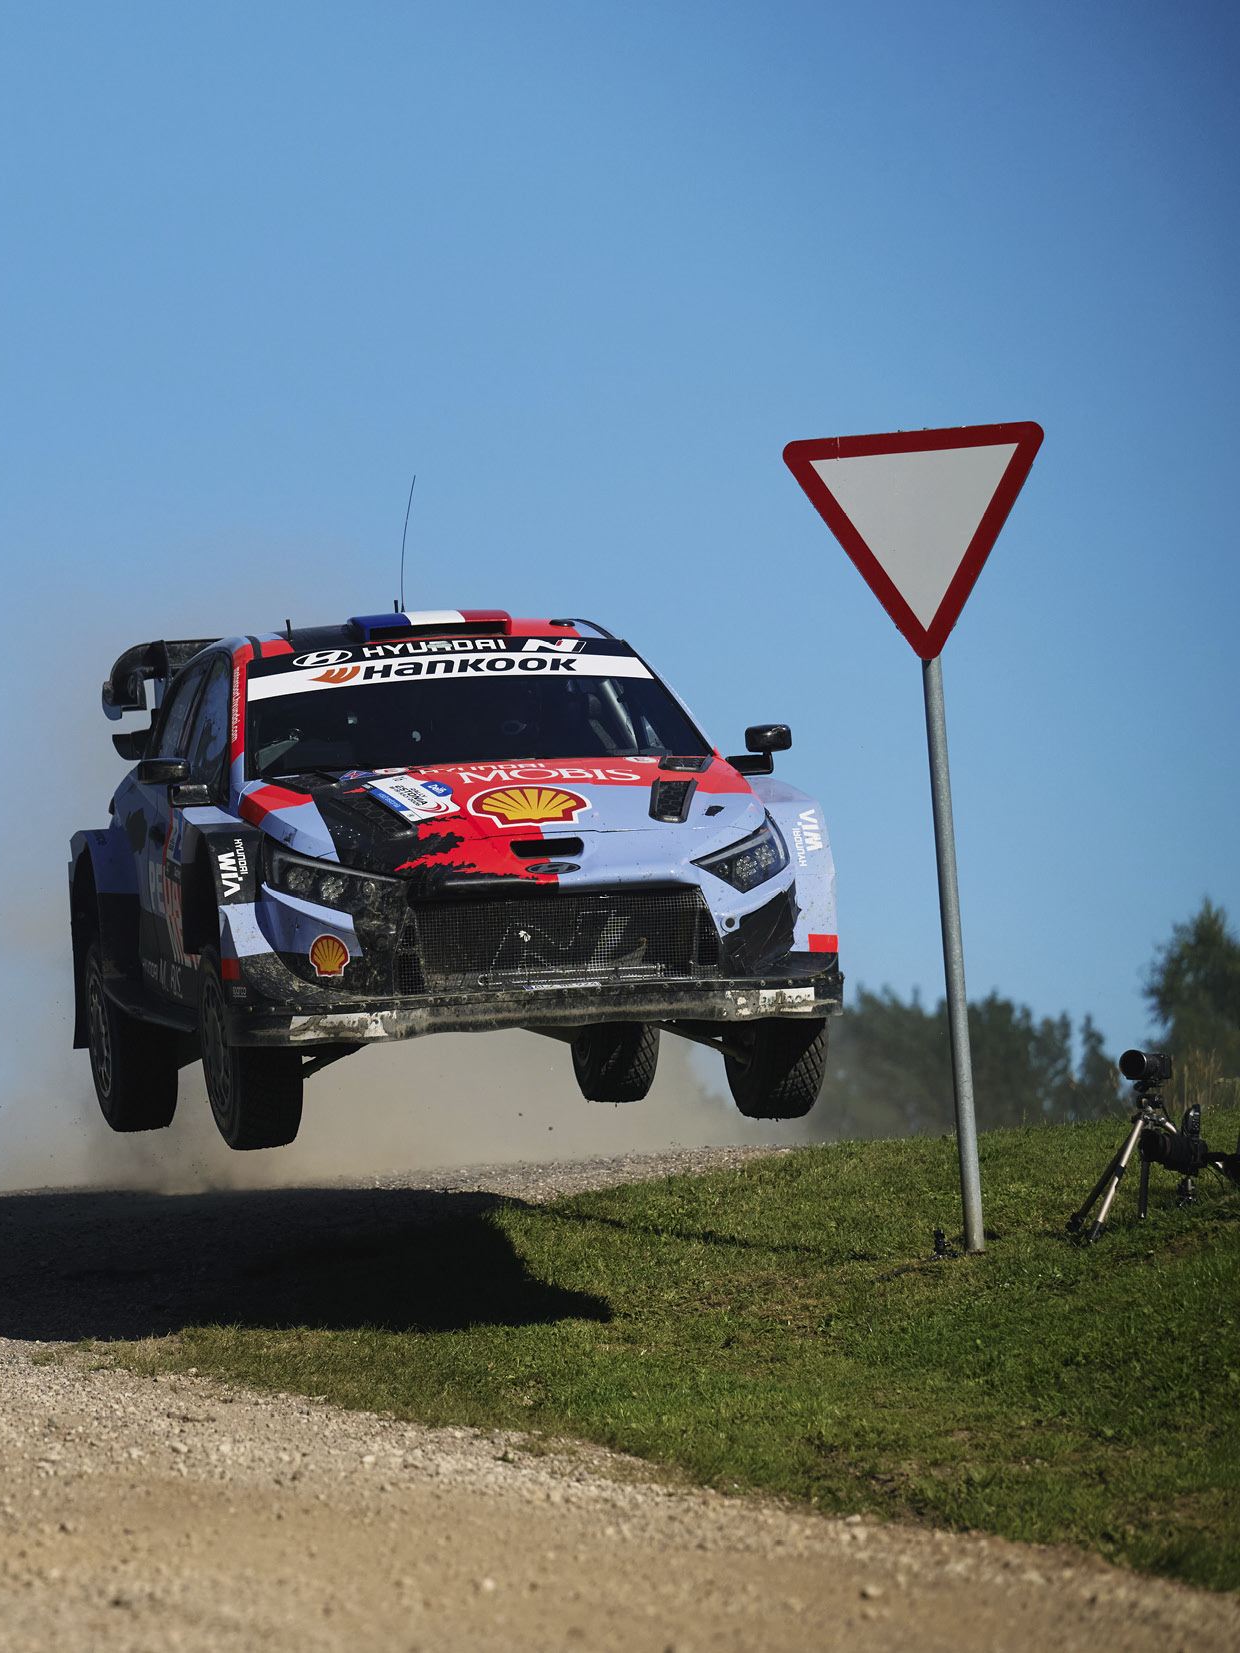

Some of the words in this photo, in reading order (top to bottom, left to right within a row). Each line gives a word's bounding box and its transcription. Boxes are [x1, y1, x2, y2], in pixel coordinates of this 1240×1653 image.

[362, 639, 507, 657] HYUNDAI
[418, 763, 546, 775] HYUNDAI
[458, 768, 641, 784] MOBIS
[234, 838, 249, 875] HYUNDAI
[792, 828, 808, 867] HYUNDAI
